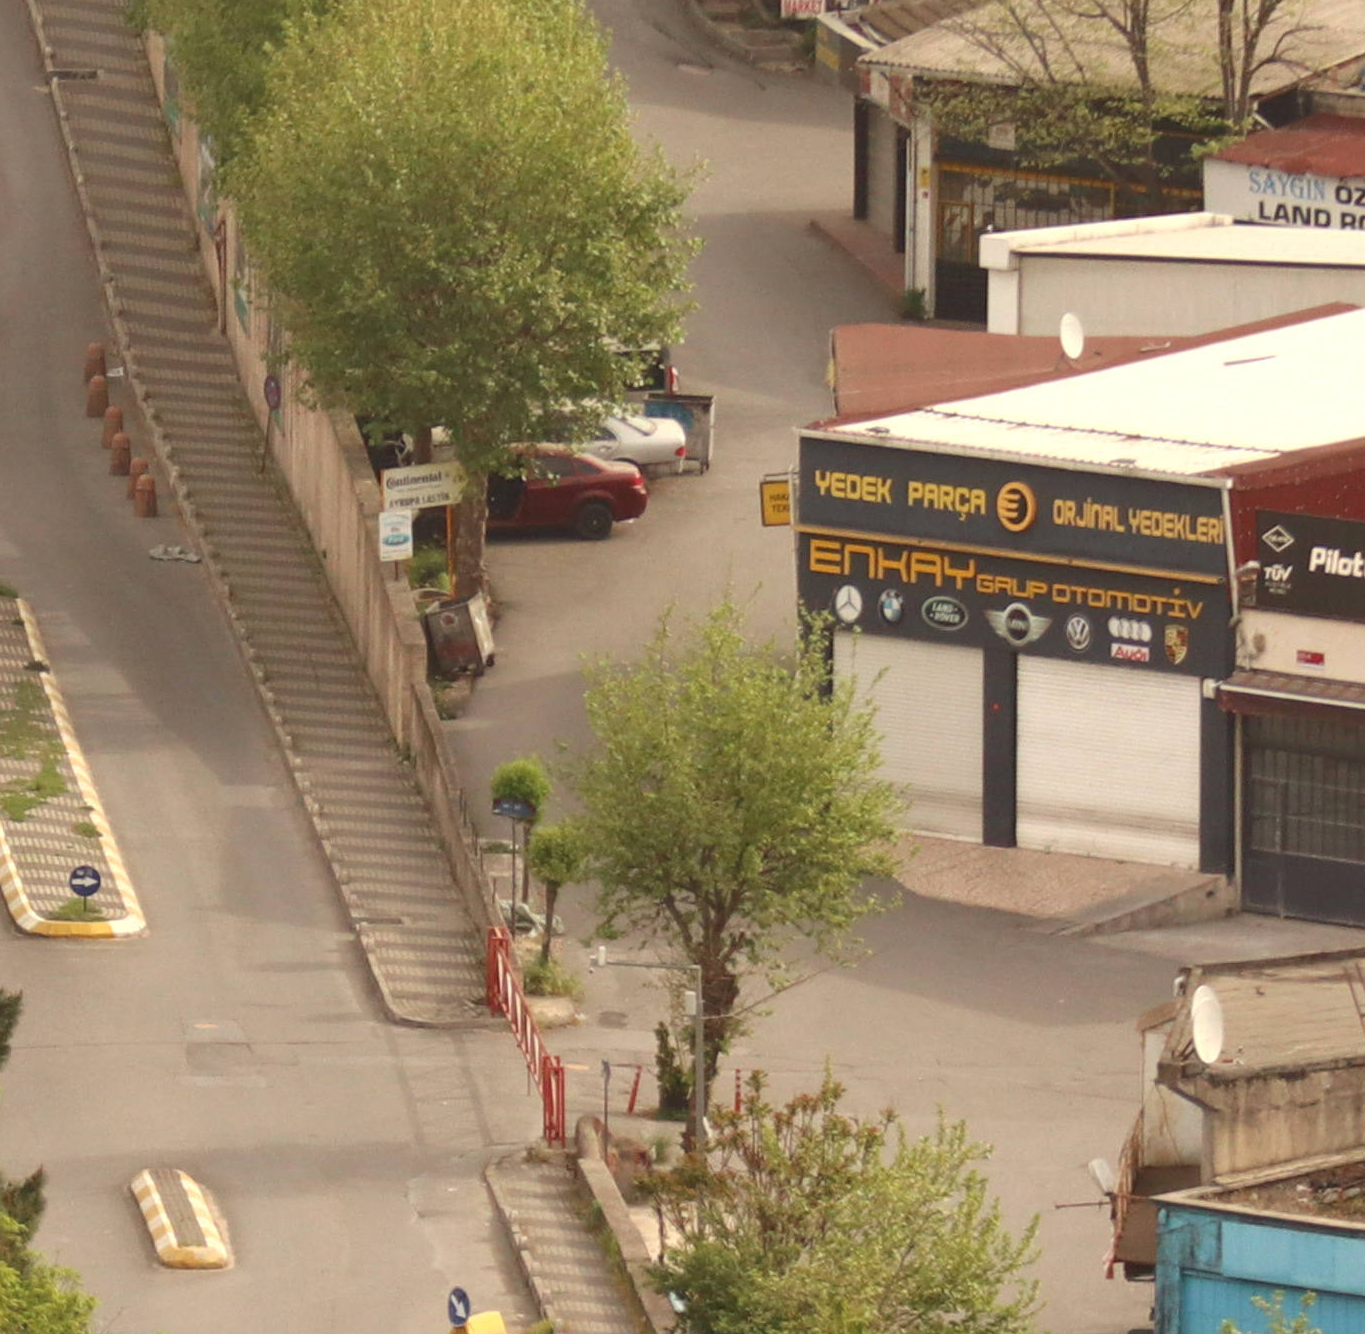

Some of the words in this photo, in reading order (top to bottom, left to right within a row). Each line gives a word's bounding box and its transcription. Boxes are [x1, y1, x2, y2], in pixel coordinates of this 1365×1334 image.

[1258, 201, 1332, 228] LAND
[386, 470, 442, 490] Continental
[815, 470, 892, 504] YEDEK
[907, 481, 986, 521] PARÇA
[1127, 506, 1226, 545] YEDEKLERİ
[1263, 562, 1293, 582] TÜV
[1309, 545, 1365, 579] Pilot
[976, 573, 1048, 600] GRUP
[1052, 584, 1204, 620] OTOMOTİV
